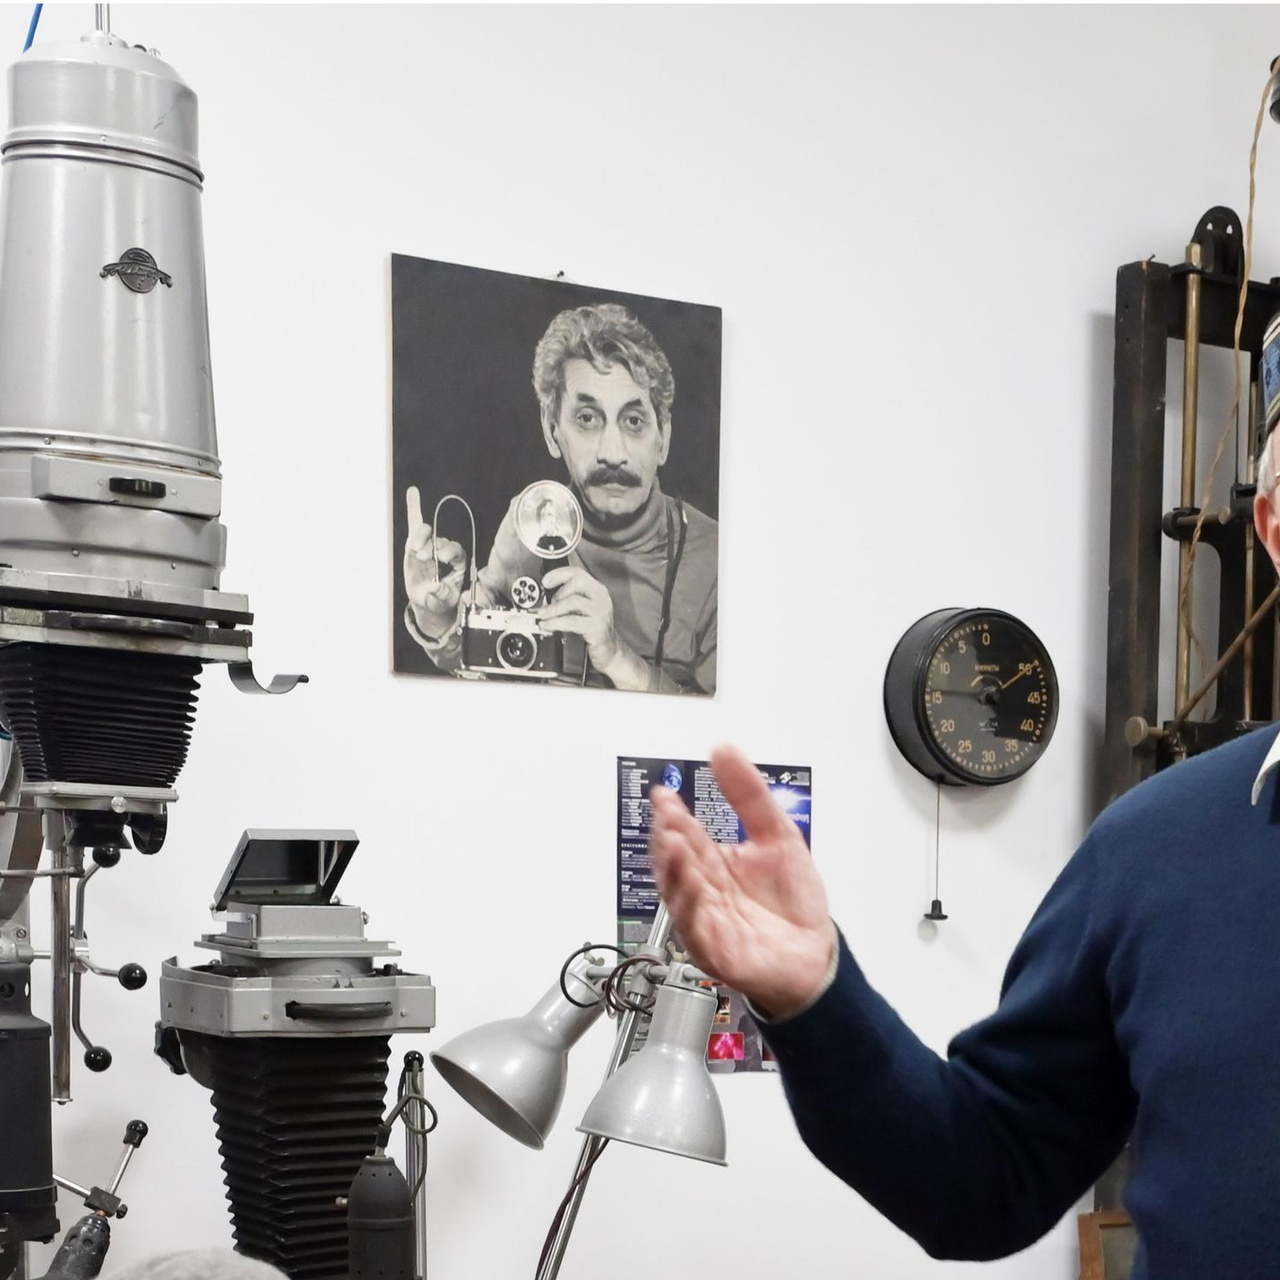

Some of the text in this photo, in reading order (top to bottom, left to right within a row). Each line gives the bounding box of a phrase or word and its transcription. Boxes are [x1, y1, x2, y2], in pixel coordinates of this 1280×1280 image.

[982, 632, 991, 646] 0
[958, 640, 967, 654] 5
[939, 663, 951, 676] 10
[931, 691, 943, 704] 15
[1027, 691, 1041, 704] 45
[940, 719, 955, 732] 20
[1020, 719, 1034, 732] 40
[957, 740, 973, 753] 25
[1004, 739, 1019, 752] 35
[981, 750, 996, 763] 30
